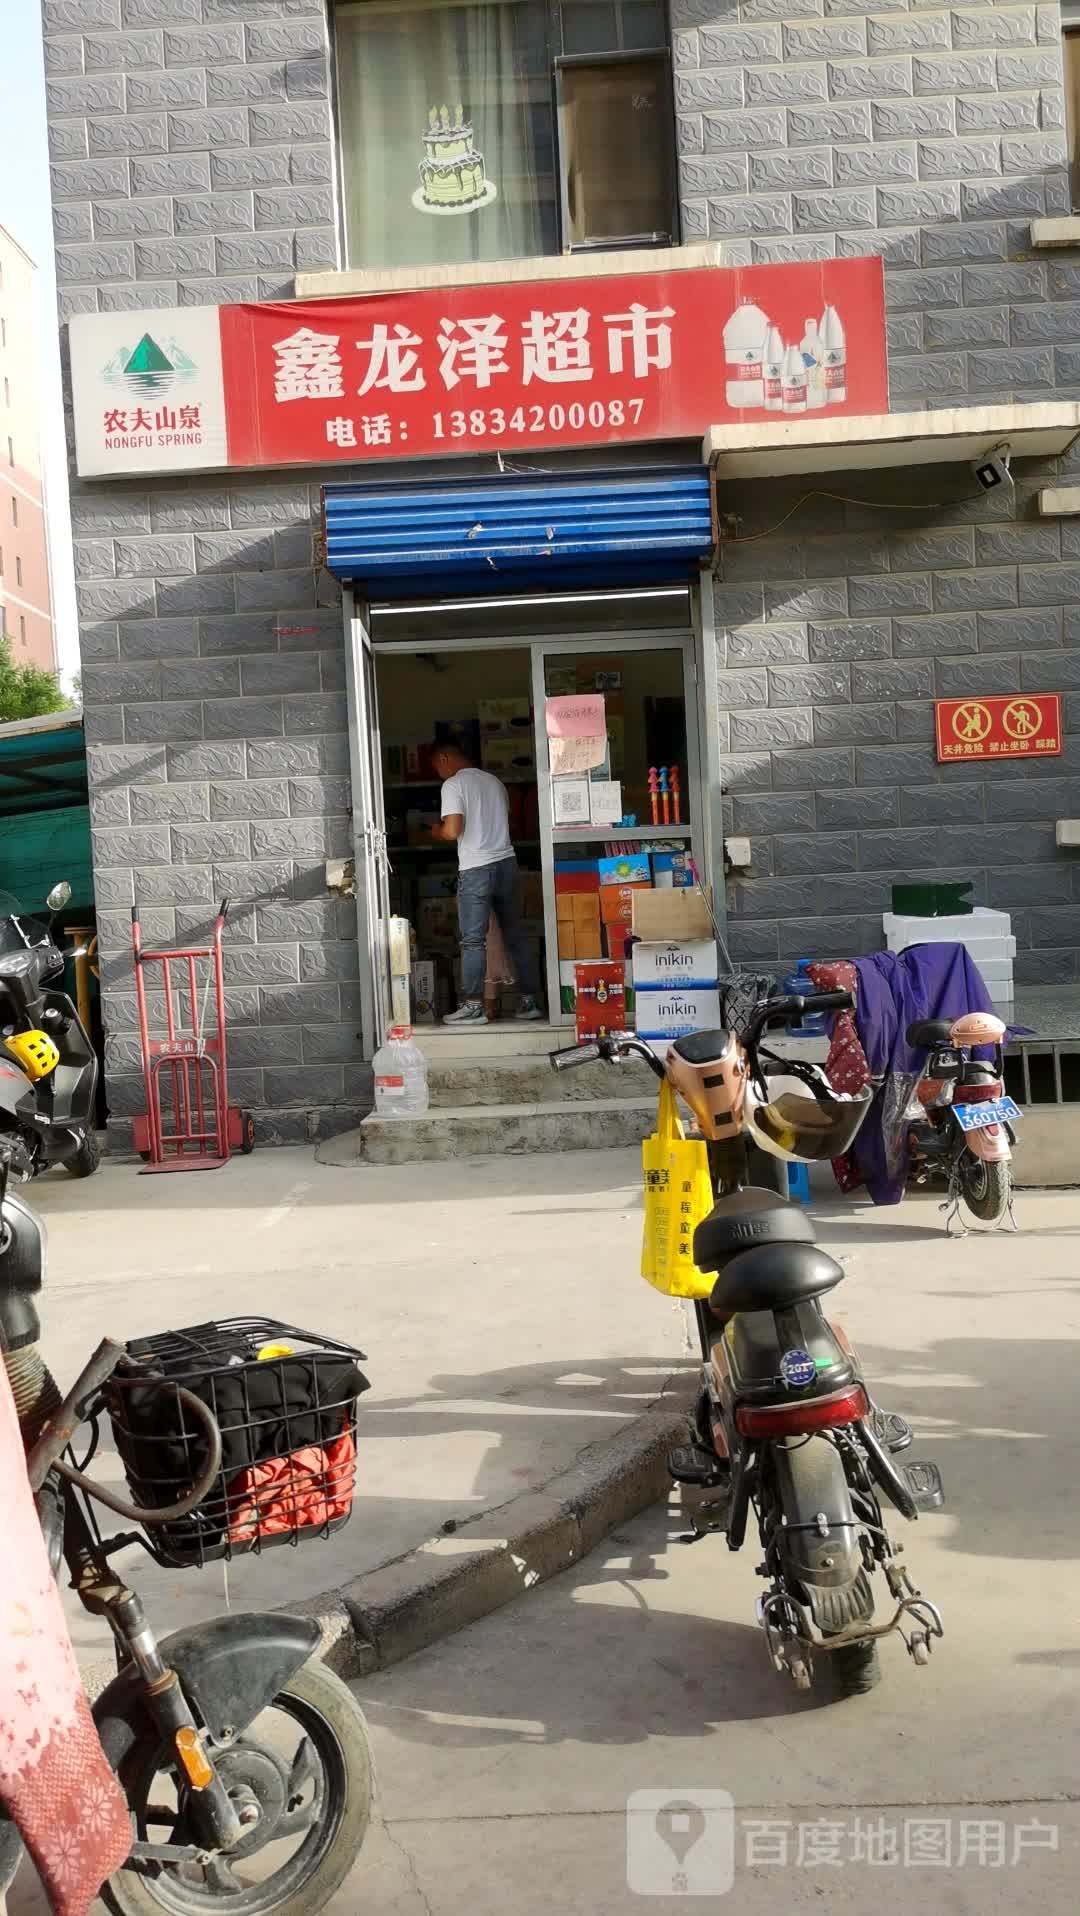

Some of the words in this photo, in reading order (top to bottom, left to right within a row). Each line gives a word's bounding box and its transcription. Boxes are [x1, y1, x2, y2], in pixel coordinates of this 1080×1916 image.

[271, 302, 676, 403] 鑫龙泽超市
[103, 404, 201, 434] 农夫山泉
[432, 398, 645, 438] 13834200087
[104, 434, 153, 450] NONGFU
[157, 432, 203, 447] SPRING
[943, 742, 984, 755] 天井危险
[988, 740, 1030, 753] 禁止坐卧
[655, 953, 693, 966] inikin
[658, 1001, 697, 1016] inikin
[159, 1041, 205, 1054] 农夫山
[962, 1107, 1018, 1127] 360750
